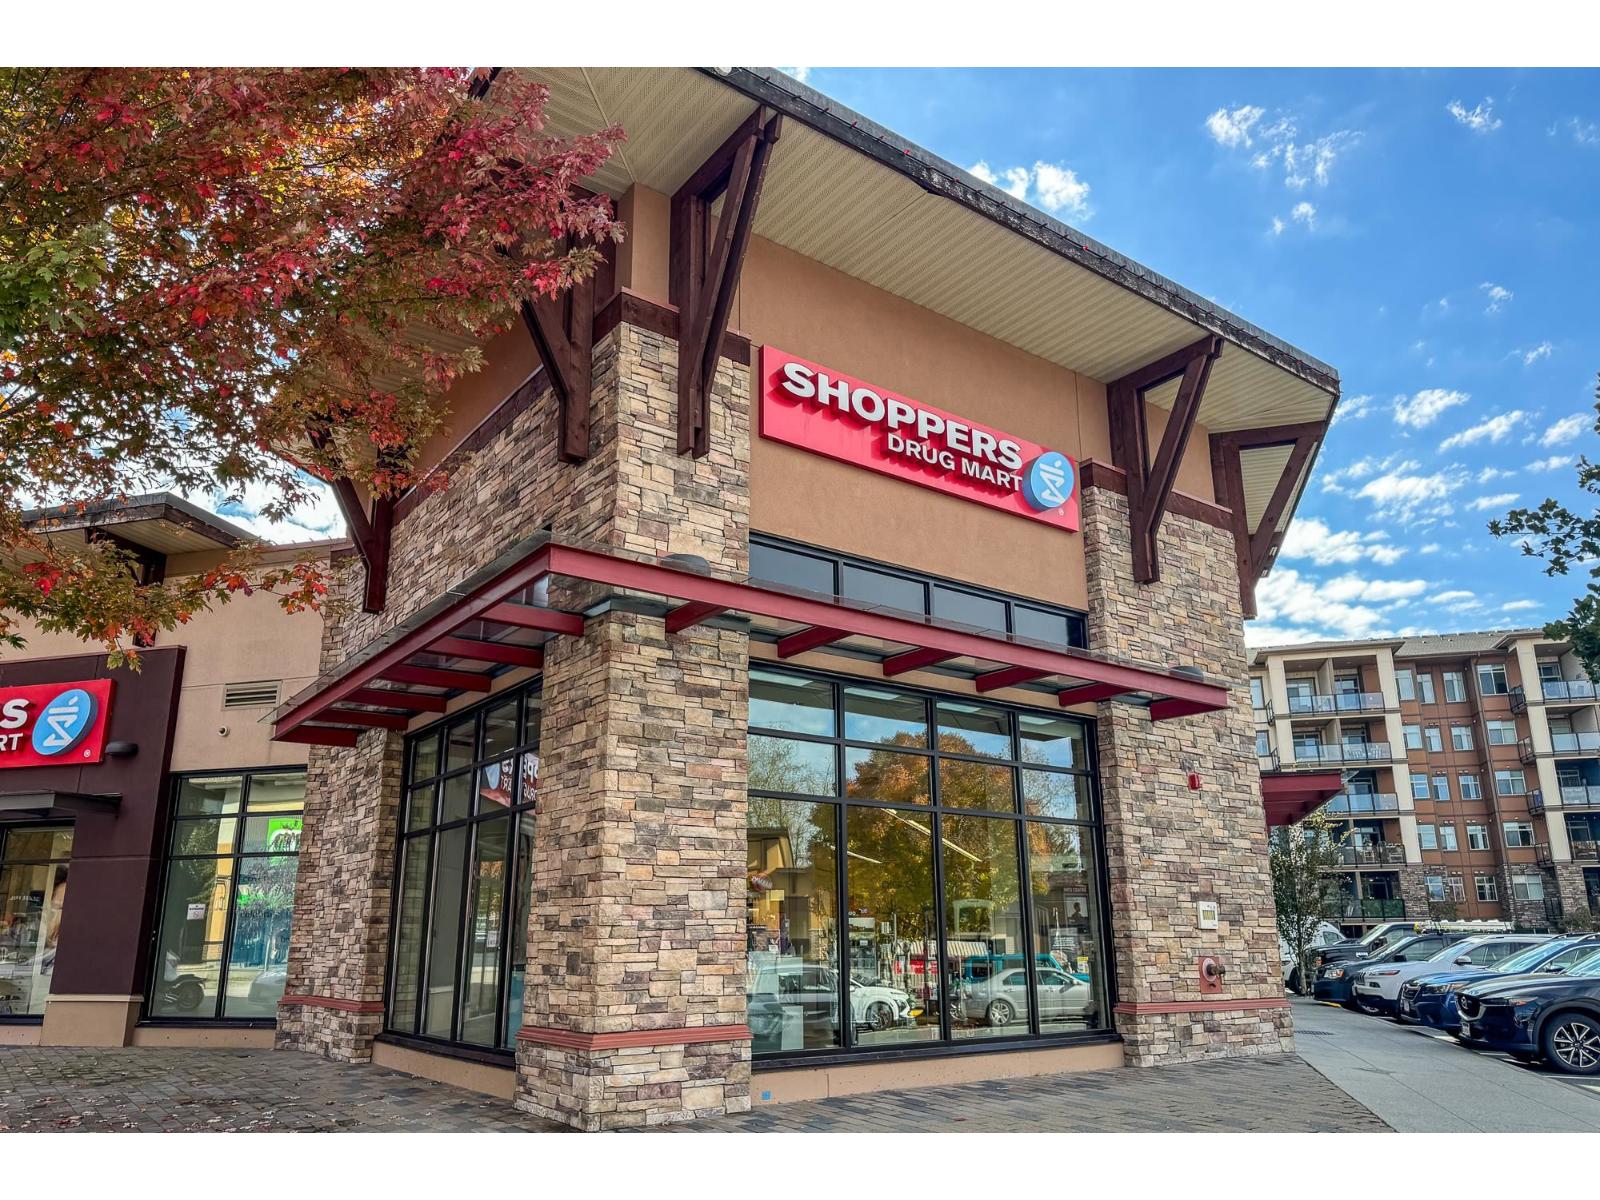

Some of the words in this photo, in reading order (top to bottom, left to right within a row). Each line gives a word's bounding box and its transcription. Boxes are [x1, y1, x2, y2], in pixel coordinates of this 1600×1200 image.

[782, 362, 1023, 470] SHOPPERS
[887, 432, 956, 471] DRUG
[961, 457, 1023, 492] MART
